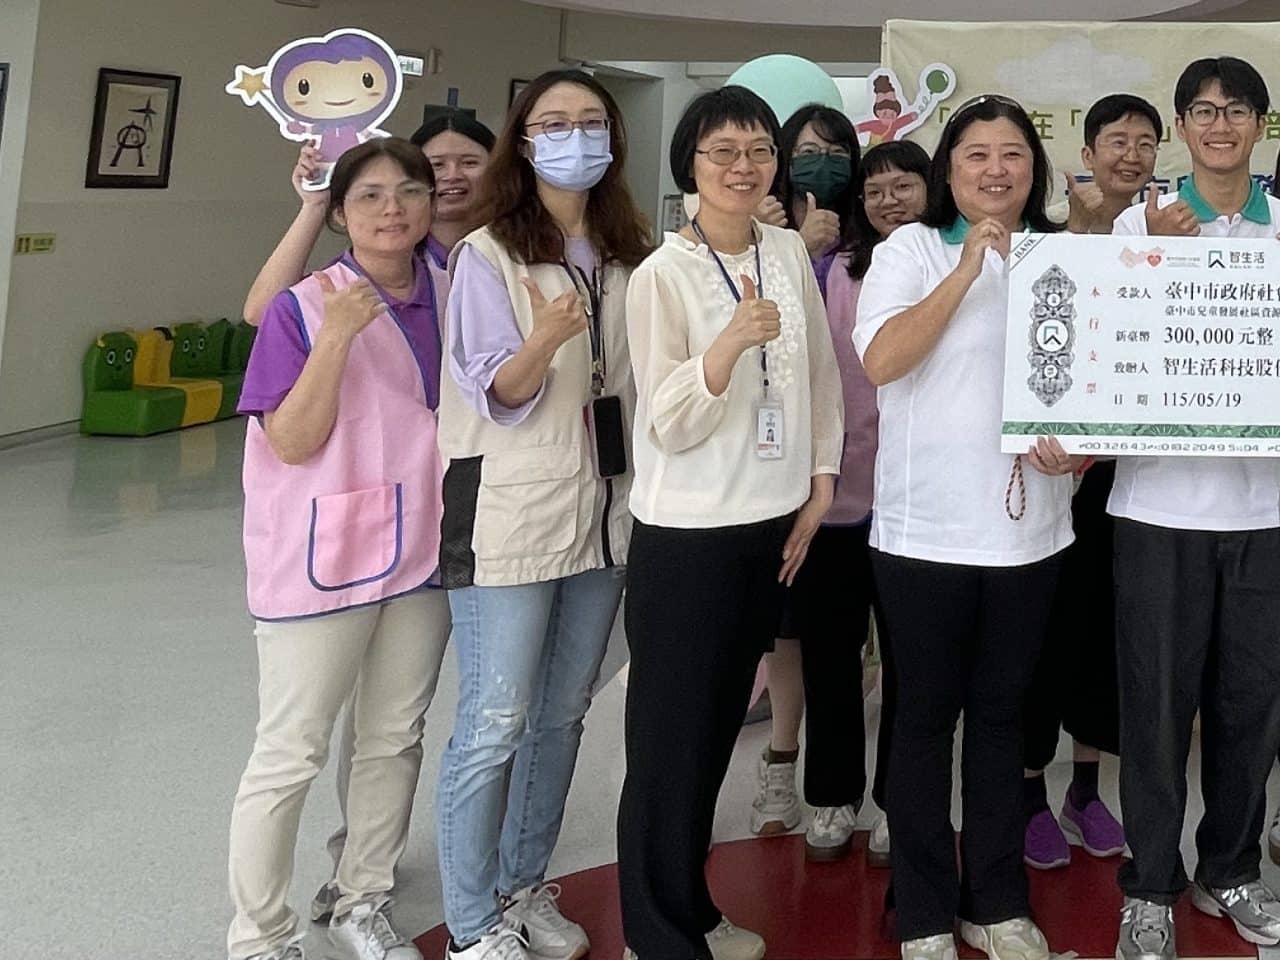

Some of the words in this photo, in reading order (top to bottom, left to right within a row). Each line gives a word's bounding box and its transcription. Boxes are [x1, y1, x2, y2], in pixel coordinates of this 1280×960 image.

[1229, 251, 1264, 264] 智生活
[1163, 326, 1234, 345] 300,000
[1162, 392, 1241, 408] 115/05/19
